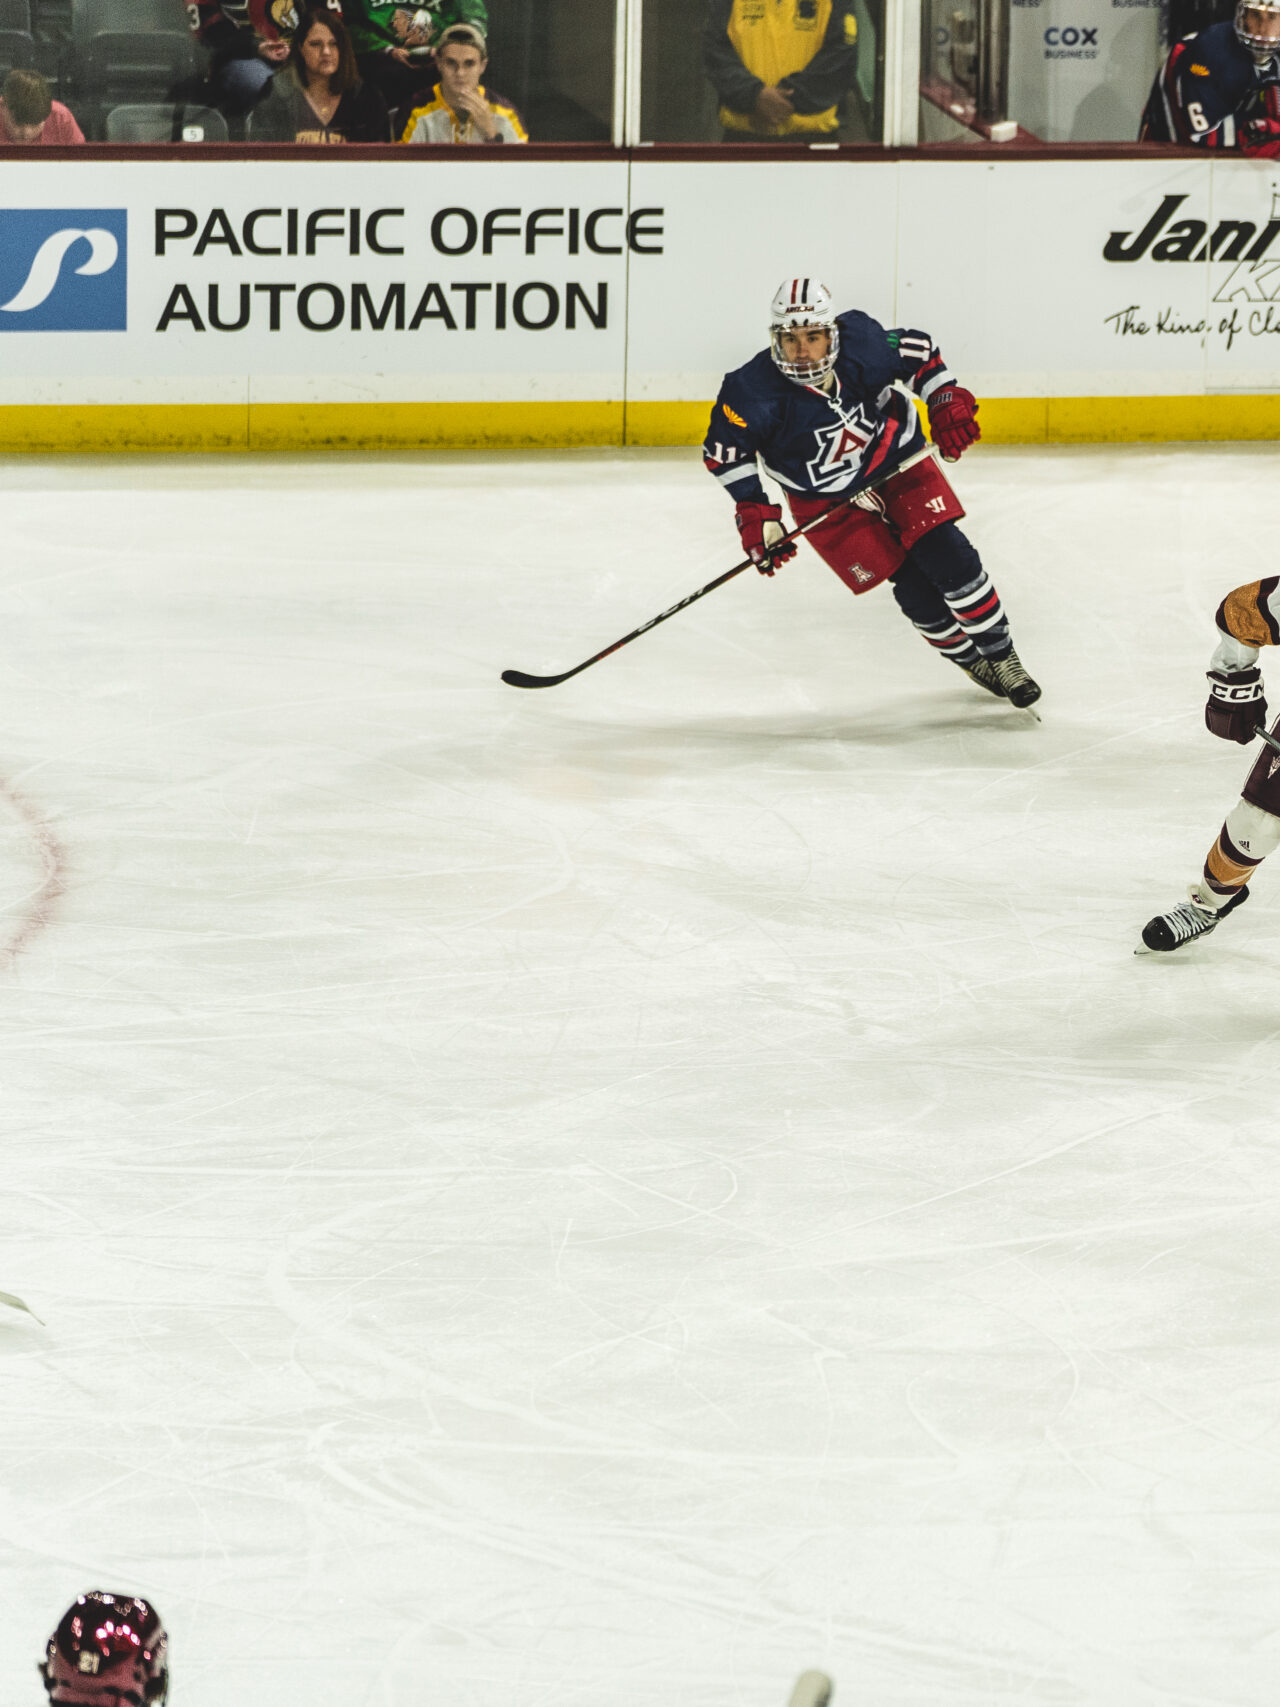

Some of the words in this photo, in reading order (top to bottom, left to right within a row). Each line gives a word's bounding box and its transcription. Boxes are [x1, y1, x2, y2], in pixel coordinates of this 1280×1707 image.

[1044, 27, 1098, 46] COX
[1044, 51, 1096, 60] BUSINESS
[1188, 102, 1209, 132] 6
[154, 208, 405, 256] PACIFIC
[430, 208, 664, 256] OFFICE
[156, 282, 608, 332] AUTOMATION
[1104, 306, 1150, 336] The
[1218, 308, 1243, 351] of
[713, 441, 737, 464] 11
[811, 408, 880, 484] A
